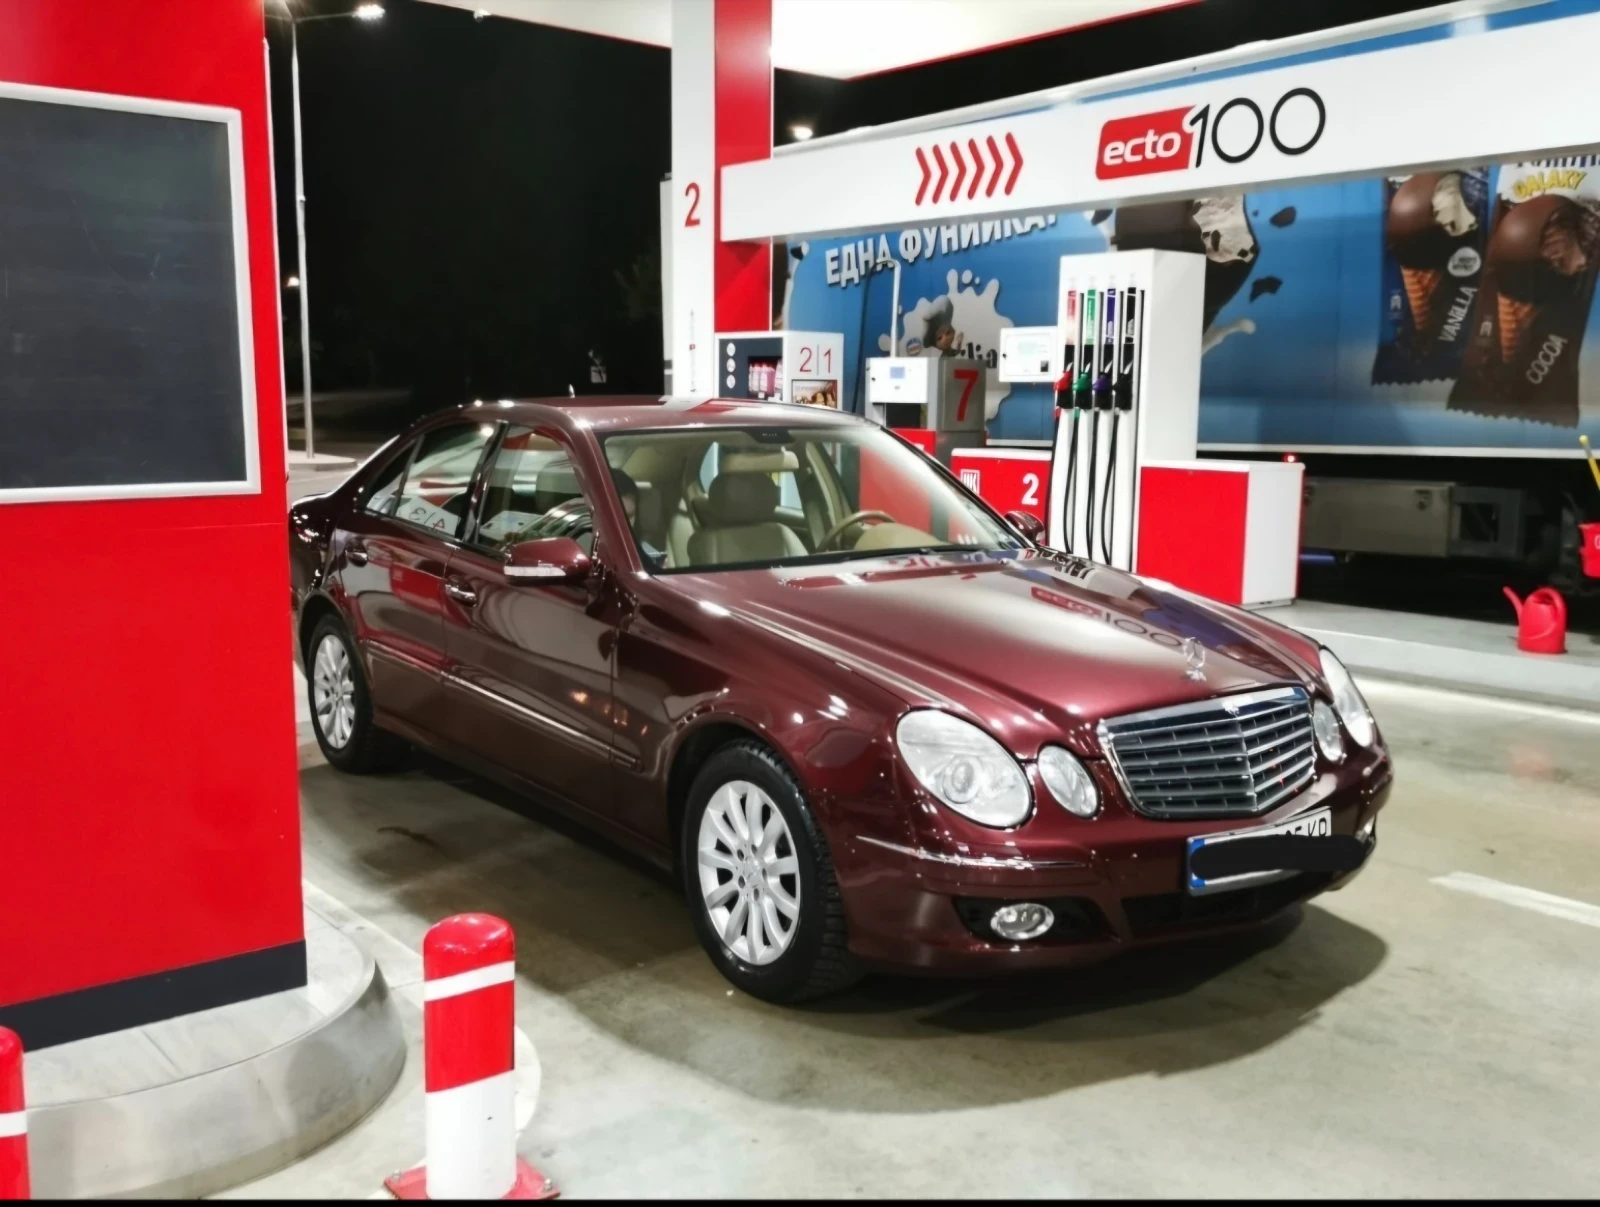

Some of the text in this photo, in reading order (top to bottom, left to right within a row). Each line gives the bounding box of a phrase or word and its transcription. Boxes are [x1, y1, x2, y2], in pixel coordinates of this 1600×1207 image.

[684, 182, 701, 227] 2
[825, 233, 894, 287] ЕДНА
[1438, 286, 1478, 342] VANILLA
[1526, 334, 1568, 384] COCOA
[953, 369, 979, 422] 7
[1021, 473, 1039, 505] 2
